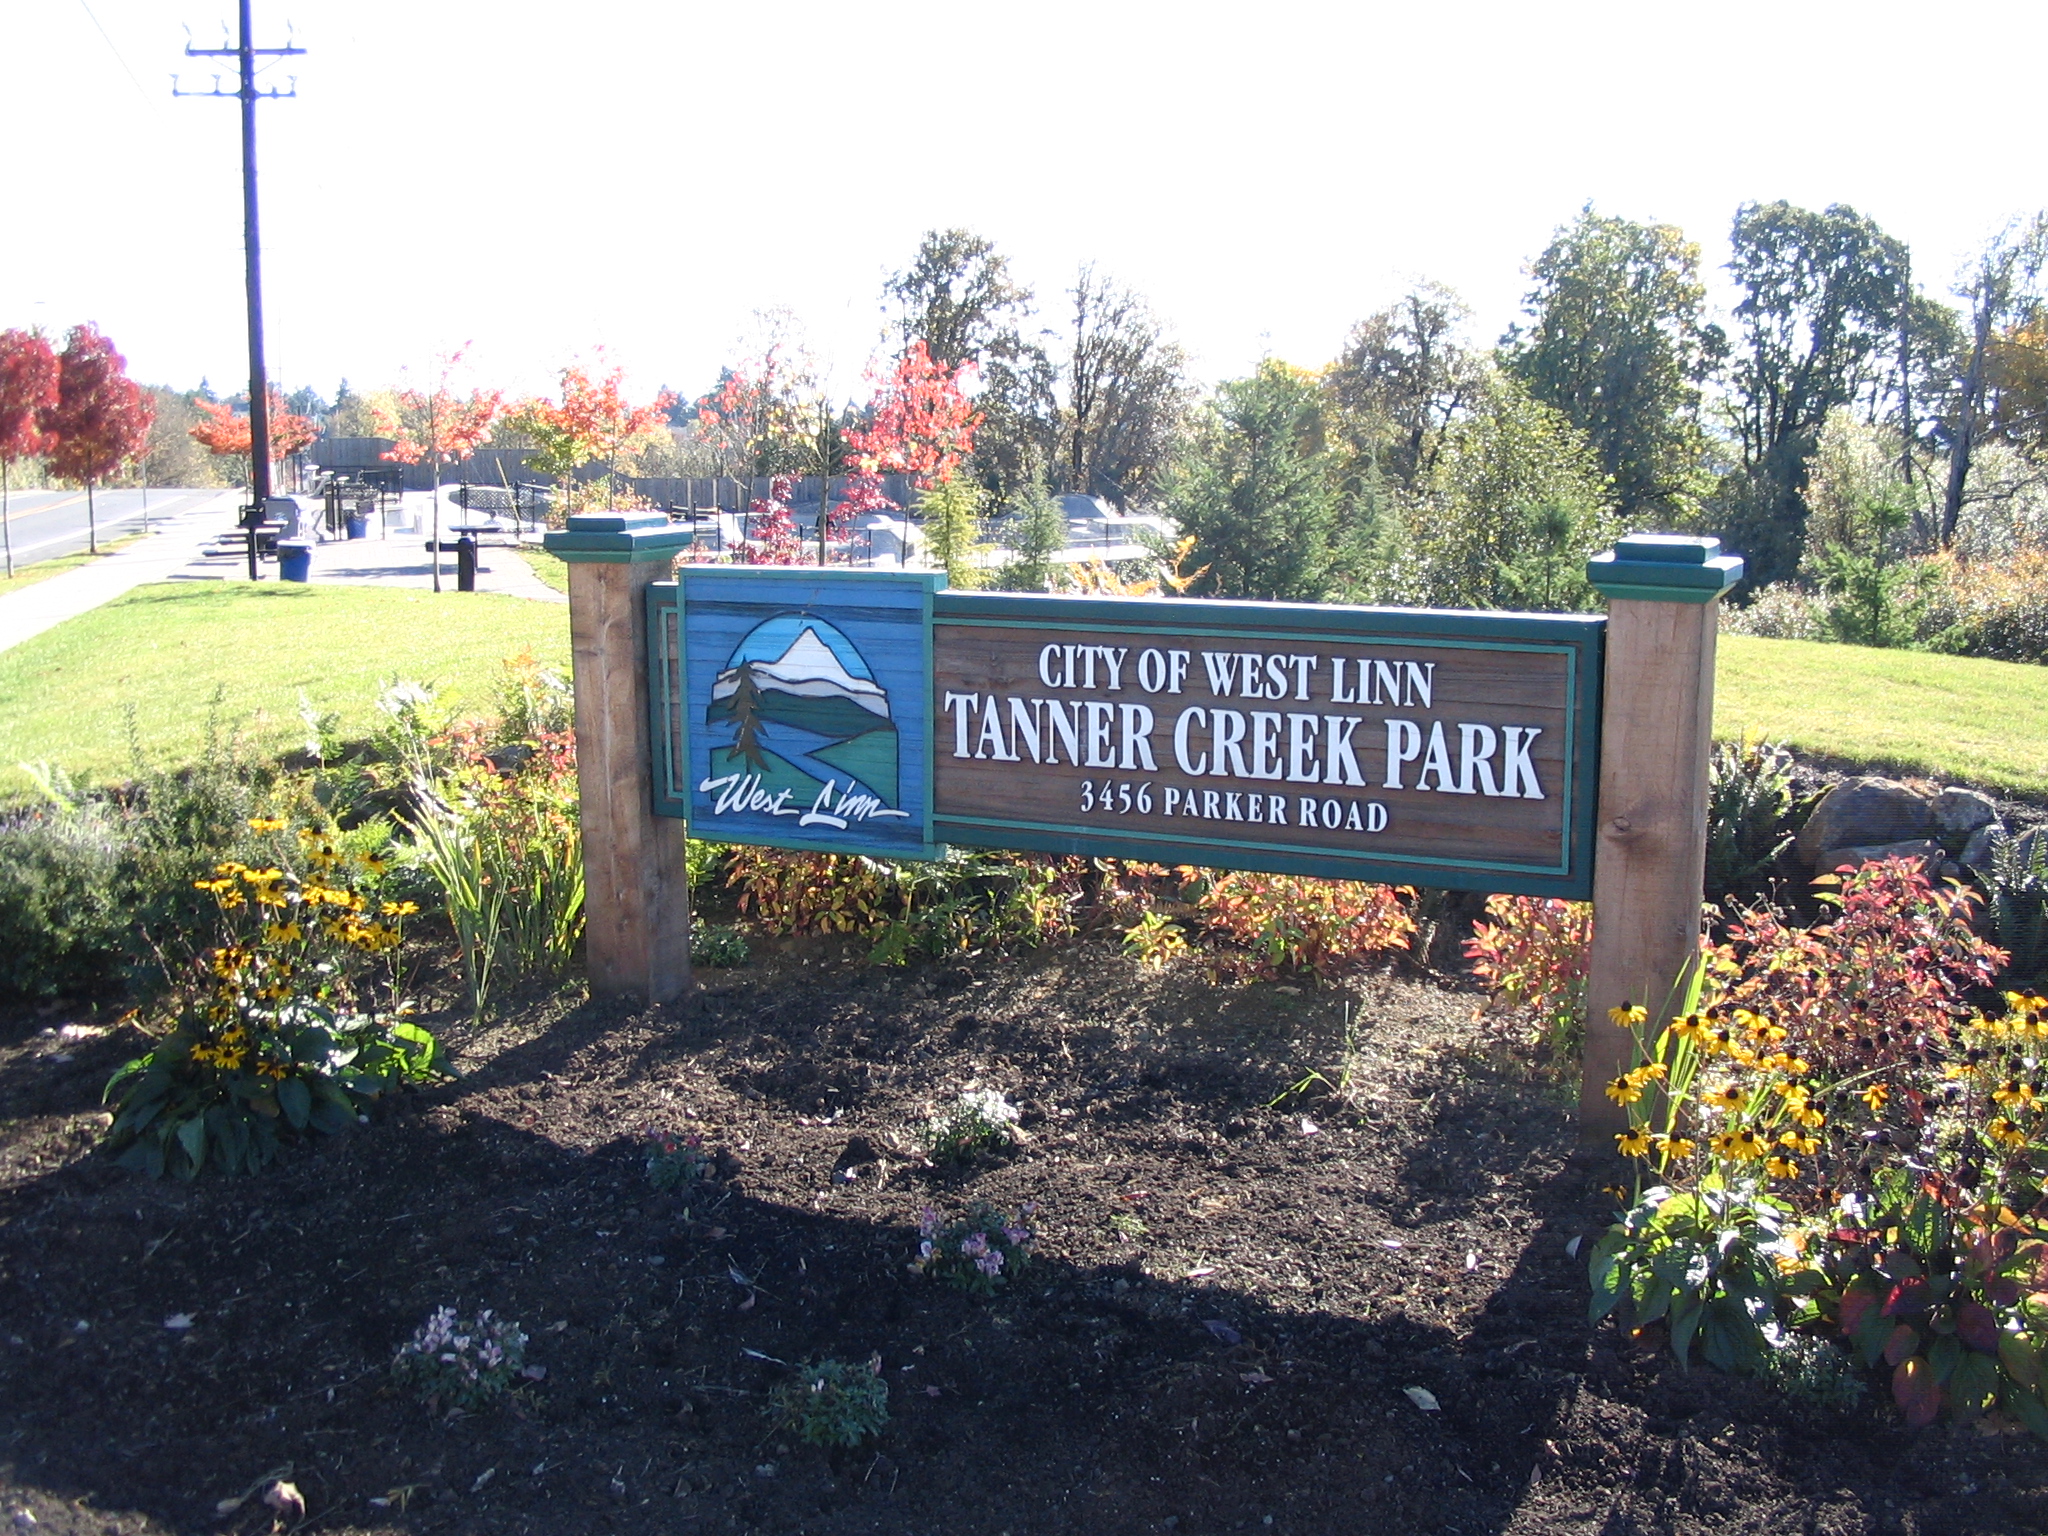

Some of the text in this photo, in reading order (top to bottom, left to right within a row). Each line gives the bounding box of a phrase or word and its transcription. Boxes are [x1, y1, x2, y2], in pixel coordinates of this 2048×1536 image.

[1039, 643, 1435, 709] CITY OF WEST LINN
[944, 690, 1545, 800] TANNER CREEK PARK
[699, 773, 910, 830] West Linn
[1080, 779, 1388, 832] 3456 PARKER ROAD
